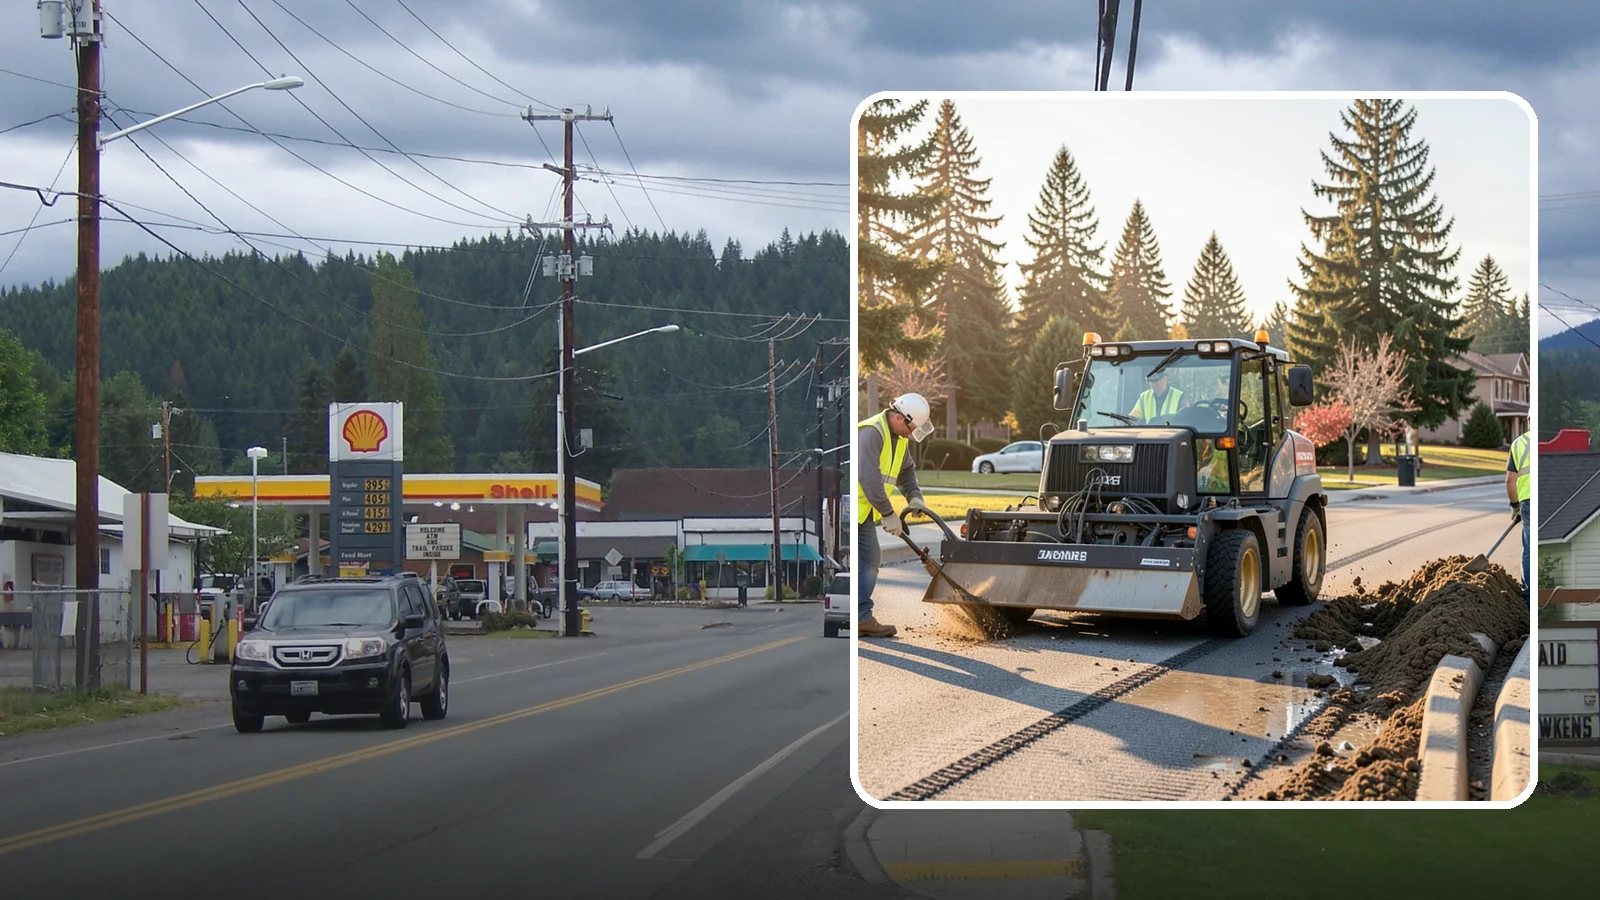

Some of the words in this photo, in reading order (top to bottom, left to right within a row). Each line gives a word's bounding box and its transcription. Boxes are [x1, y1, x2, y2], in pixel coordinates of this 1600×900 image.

[366, 480, 384, 490] 395
[490, 484, 547, 499] Shell
[366, 494, 384, 504] 405
[366, 508, 384, 518] 415
[366, 522, 384, 532] 429
[1539, 643, 1567, 665] AID
